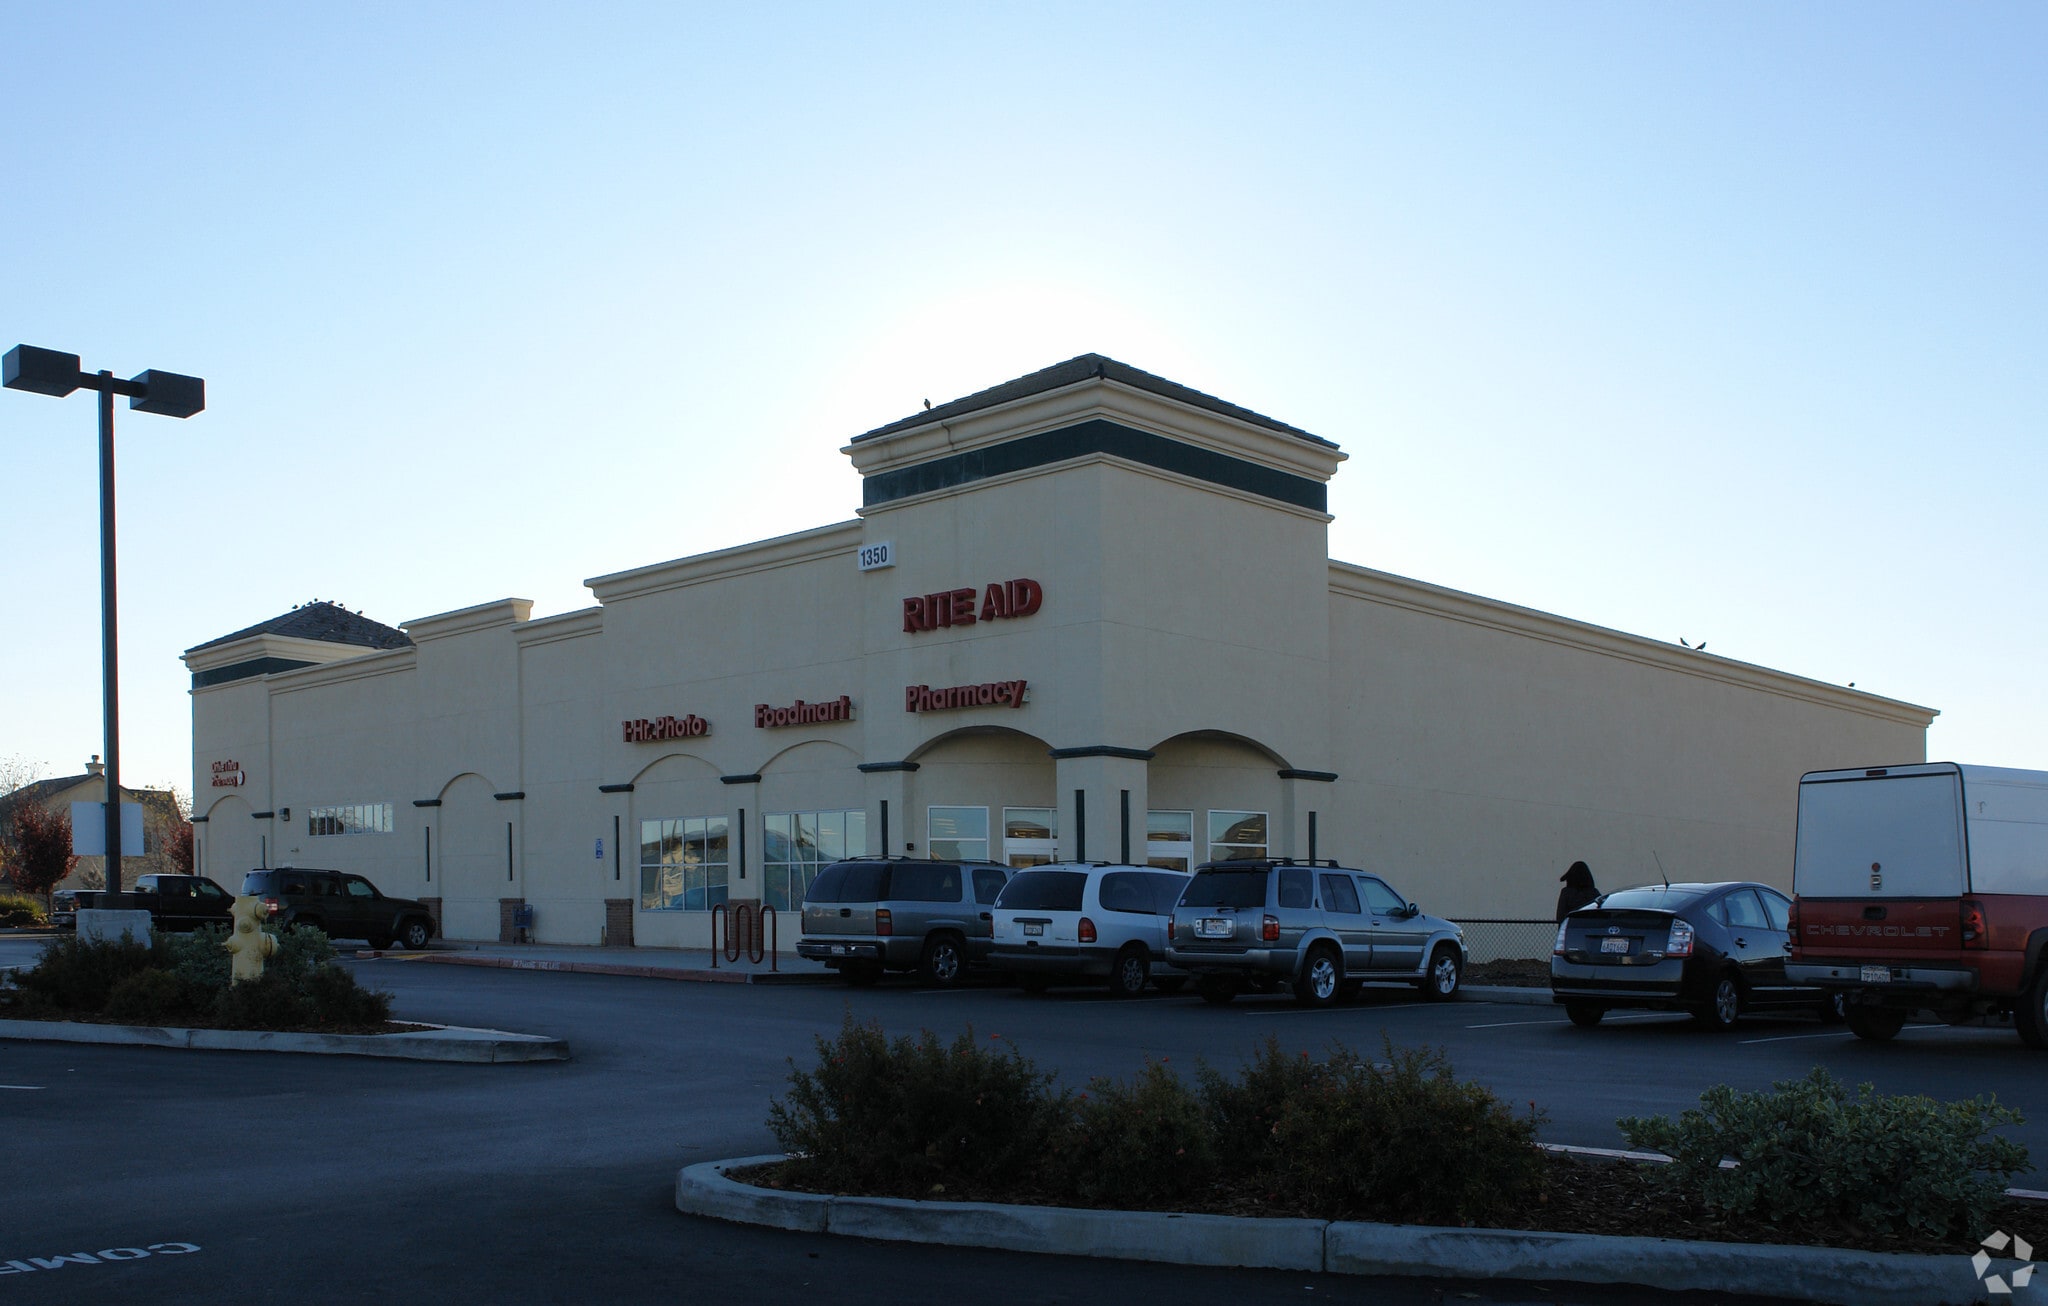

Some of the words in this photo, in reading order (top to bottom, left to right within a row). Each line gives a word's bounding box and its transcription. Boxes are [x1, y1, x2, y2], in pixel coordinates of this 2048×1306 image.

[860, 545, 888, 567] 1350
[902, 587, 977, 633] RITE
[979, 578, 1043, 621] AID
[905, 679, 1028, 713] Pharmacy
[655, 714, 707, 740] Photo
[755, 695, 851, 729] Foodmart
[1806, 924, 1950, 937] CHEVROLET
